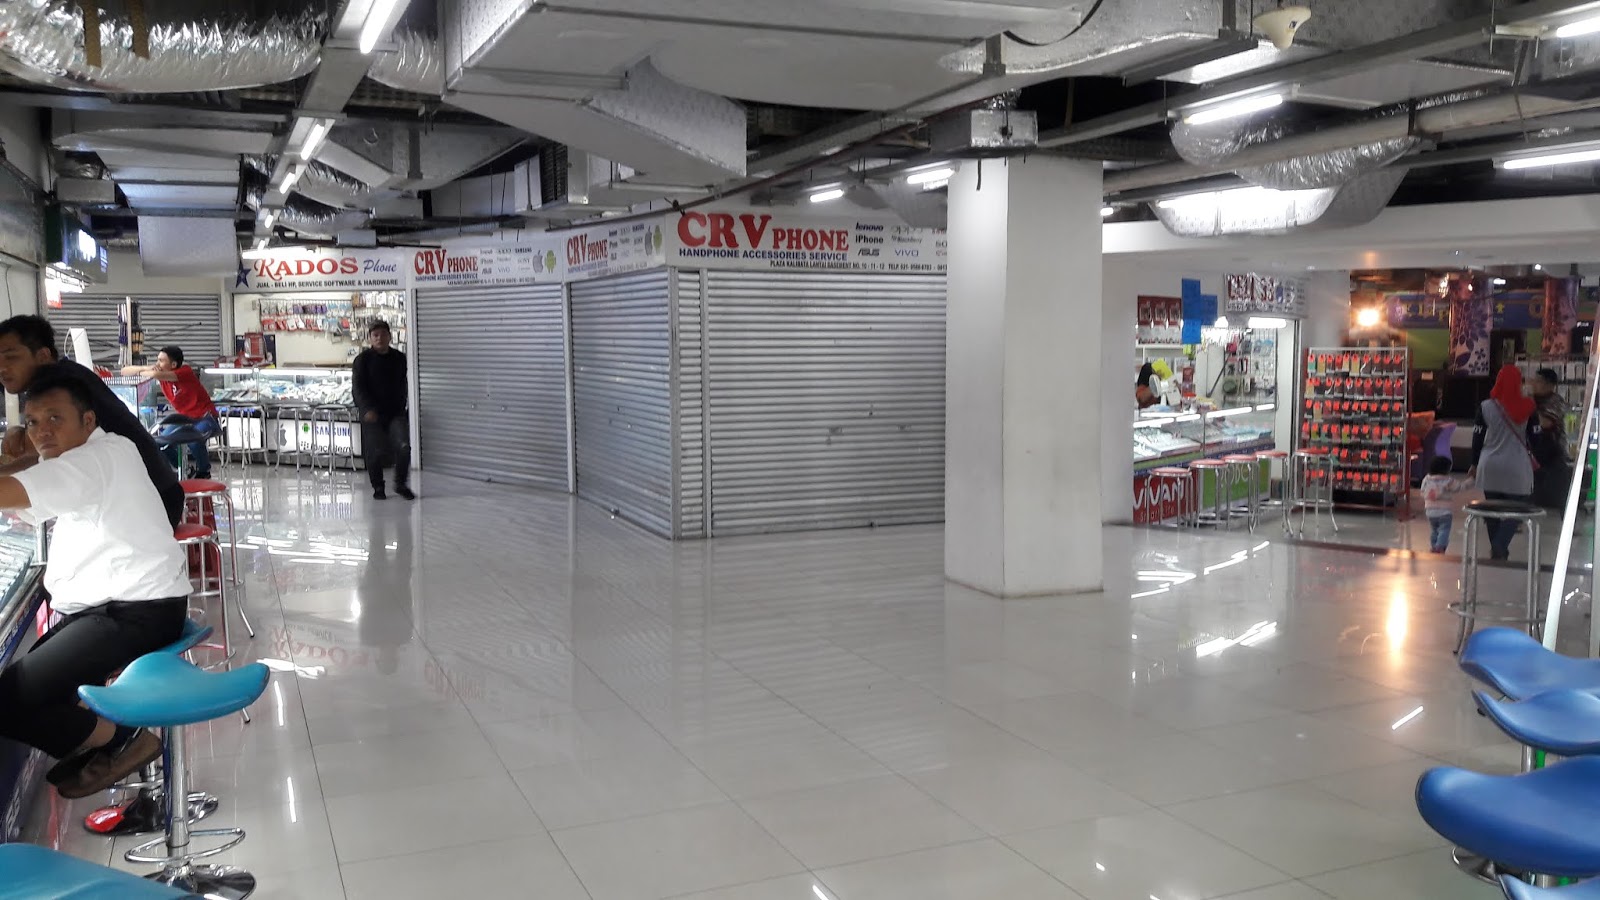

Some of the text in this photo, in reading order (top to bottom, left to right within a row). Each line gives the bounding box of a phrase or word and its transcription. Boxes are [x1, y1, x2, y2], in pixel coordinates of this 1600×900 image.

[677, 211, 772, 250] CRV
[772, 227, 849, 251] PHONE
[855, 222, 884, 232] lenovo
[855, 235, 884, 244] iPhone
[566, 233, 588, 267] CRV
[587, 239, 609, 262] PHONE
[679, 248, 849, 261] HANDPHONE ACCESSORIES SERVICE
[857, 248, 881, 257] ASUS
[414, 248, 479, 276] CRV PHONE
[253, 256, 398, 281] KADOS Phone
[461, 272, 478, 280] SERVICE
[256, 281, 270, 289] JUAL
[298, 280, 323, 288] SERVICE
[323, 279, 356, 288] SOFTWARE
[363, 278, 399, 287] HARDWARE
[314, 425, 352, 437] SASUN
